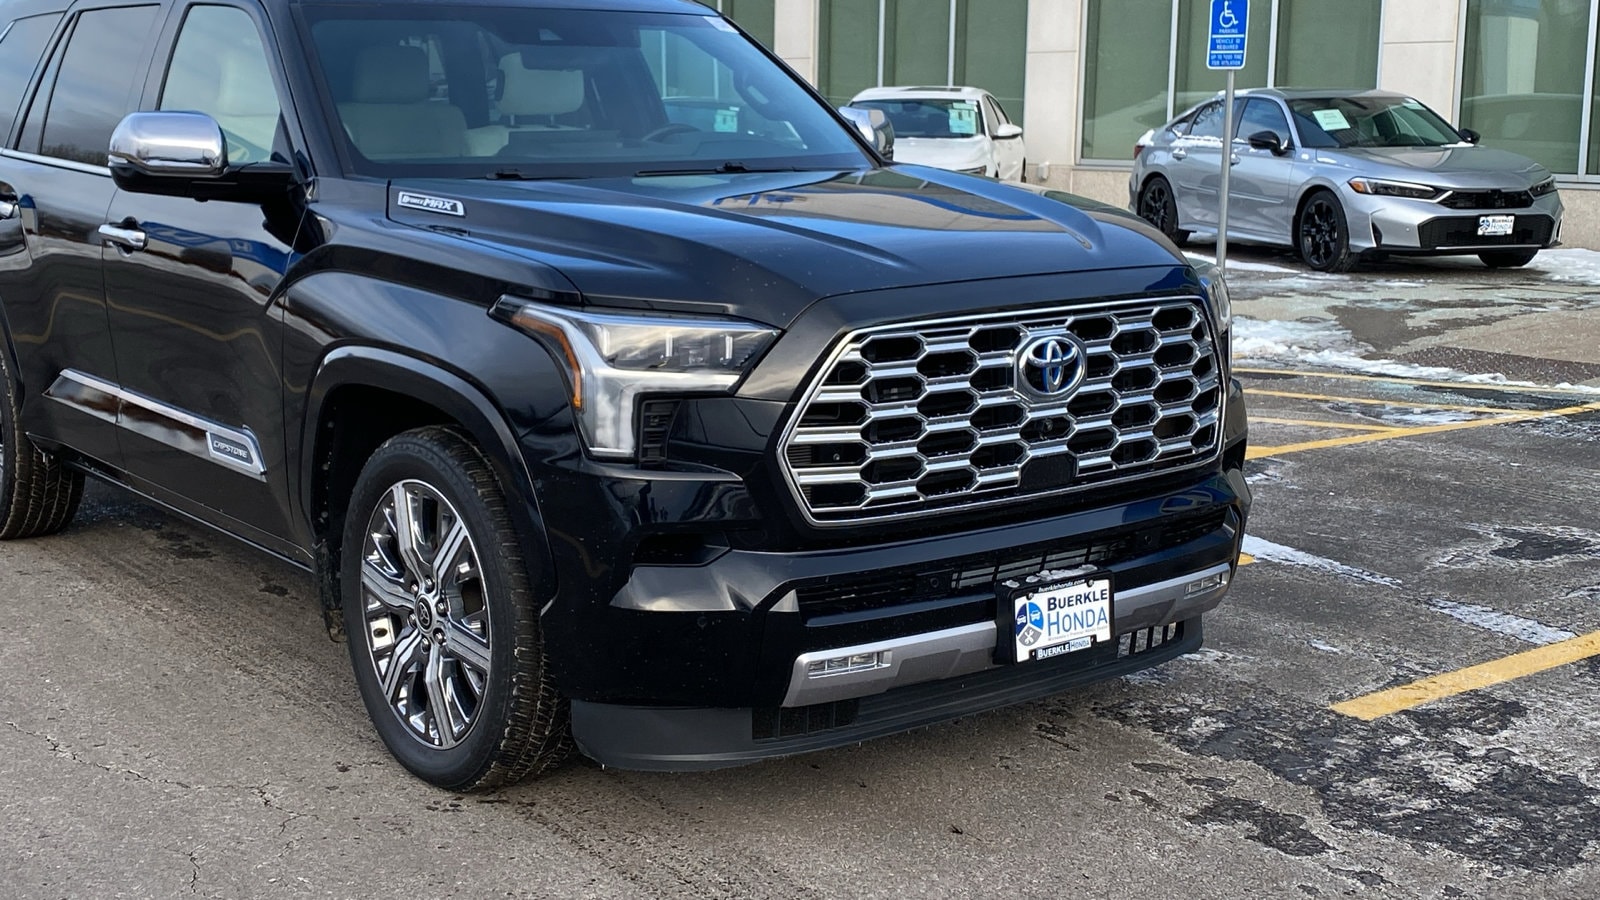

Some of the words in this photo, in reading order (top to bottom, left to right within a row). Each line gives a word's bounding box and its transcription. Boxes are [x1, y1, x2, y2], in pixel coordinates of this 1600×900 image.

[423, 198, 453, 210] MAX
[214, 440, 248, 458] CAPSTONE
[1047, 588, 1108, 612] BUERKLE
[1047, 606, 1108, 636] HONDA
[1038, 643, 1070, 658] BUERKLE
[1070, 638, 1090, 650] HONDA
